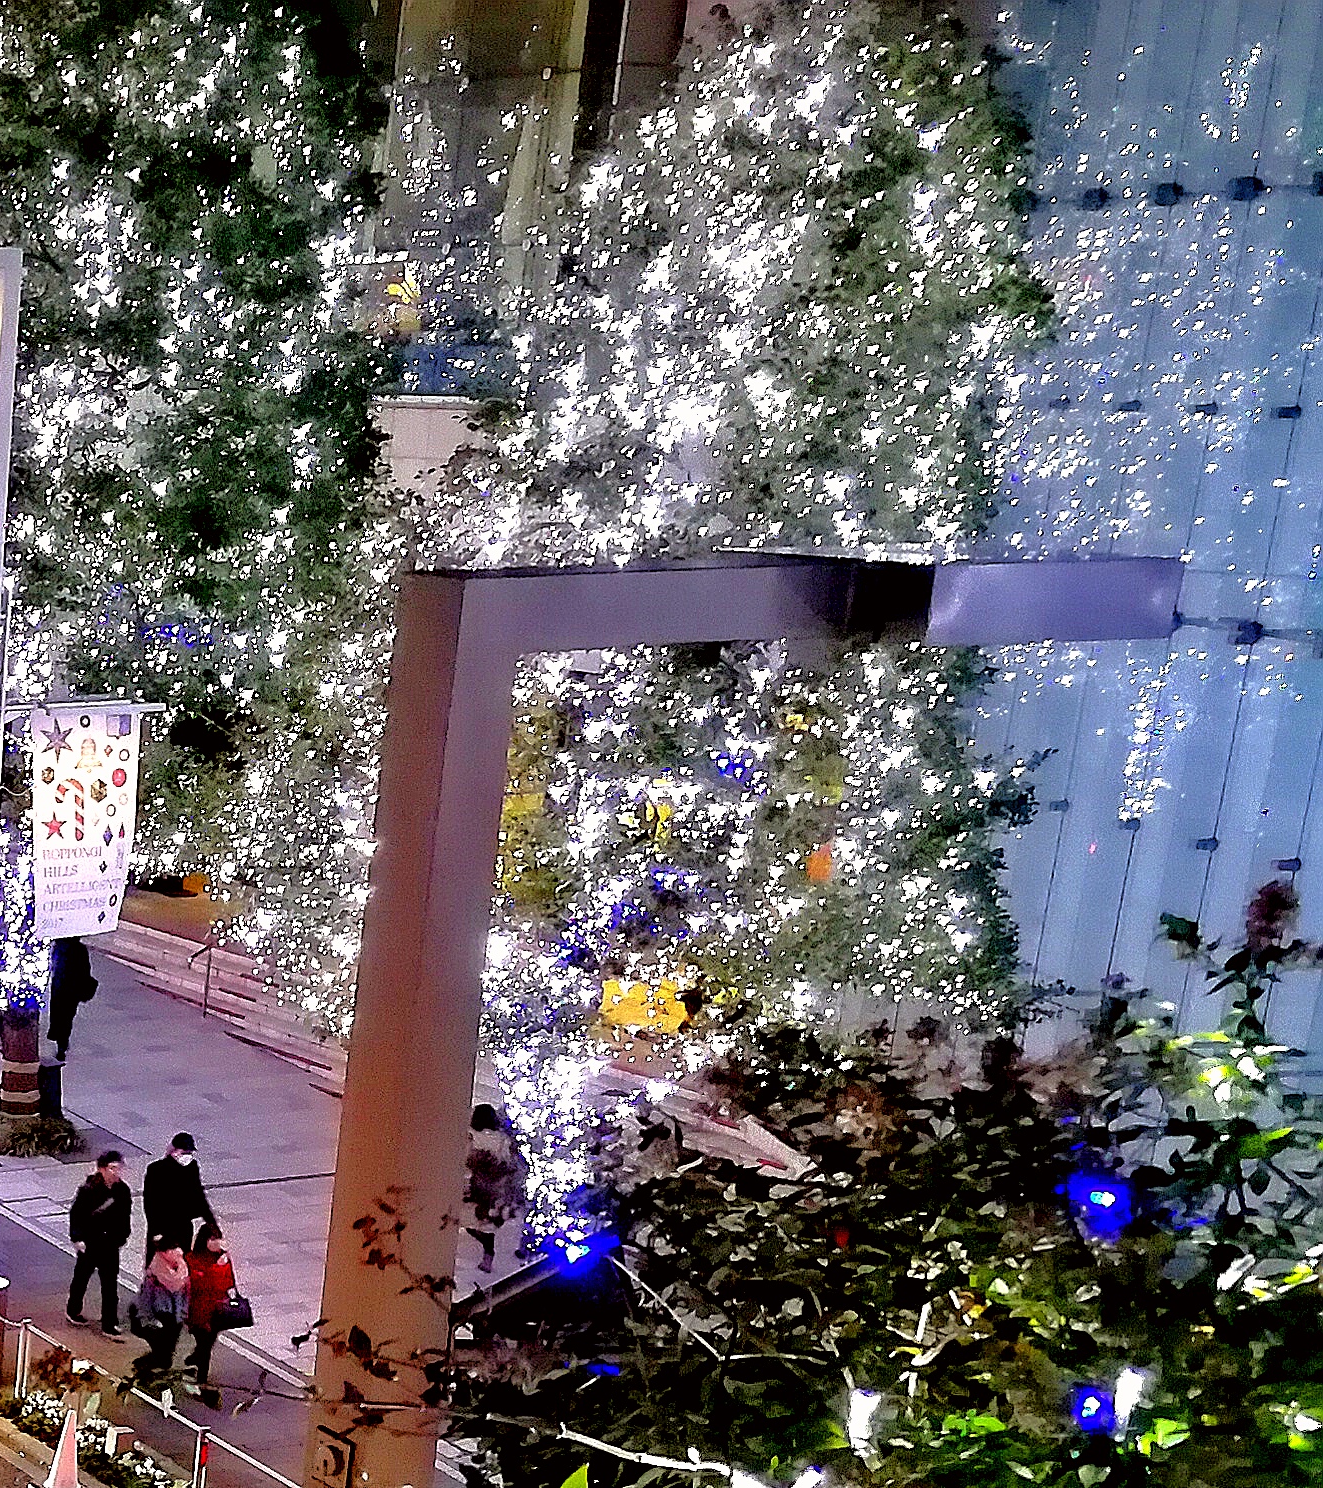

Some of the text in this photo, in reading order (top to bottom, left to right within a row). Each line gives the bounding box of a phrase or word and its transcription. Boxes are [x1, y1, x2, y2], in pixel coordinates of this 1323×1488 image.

[42, 845, 103, 861] ROPPONGI
[43, 864, 79, 878] HILLS
[42, 896, 107, 913] CHRISTMAS
